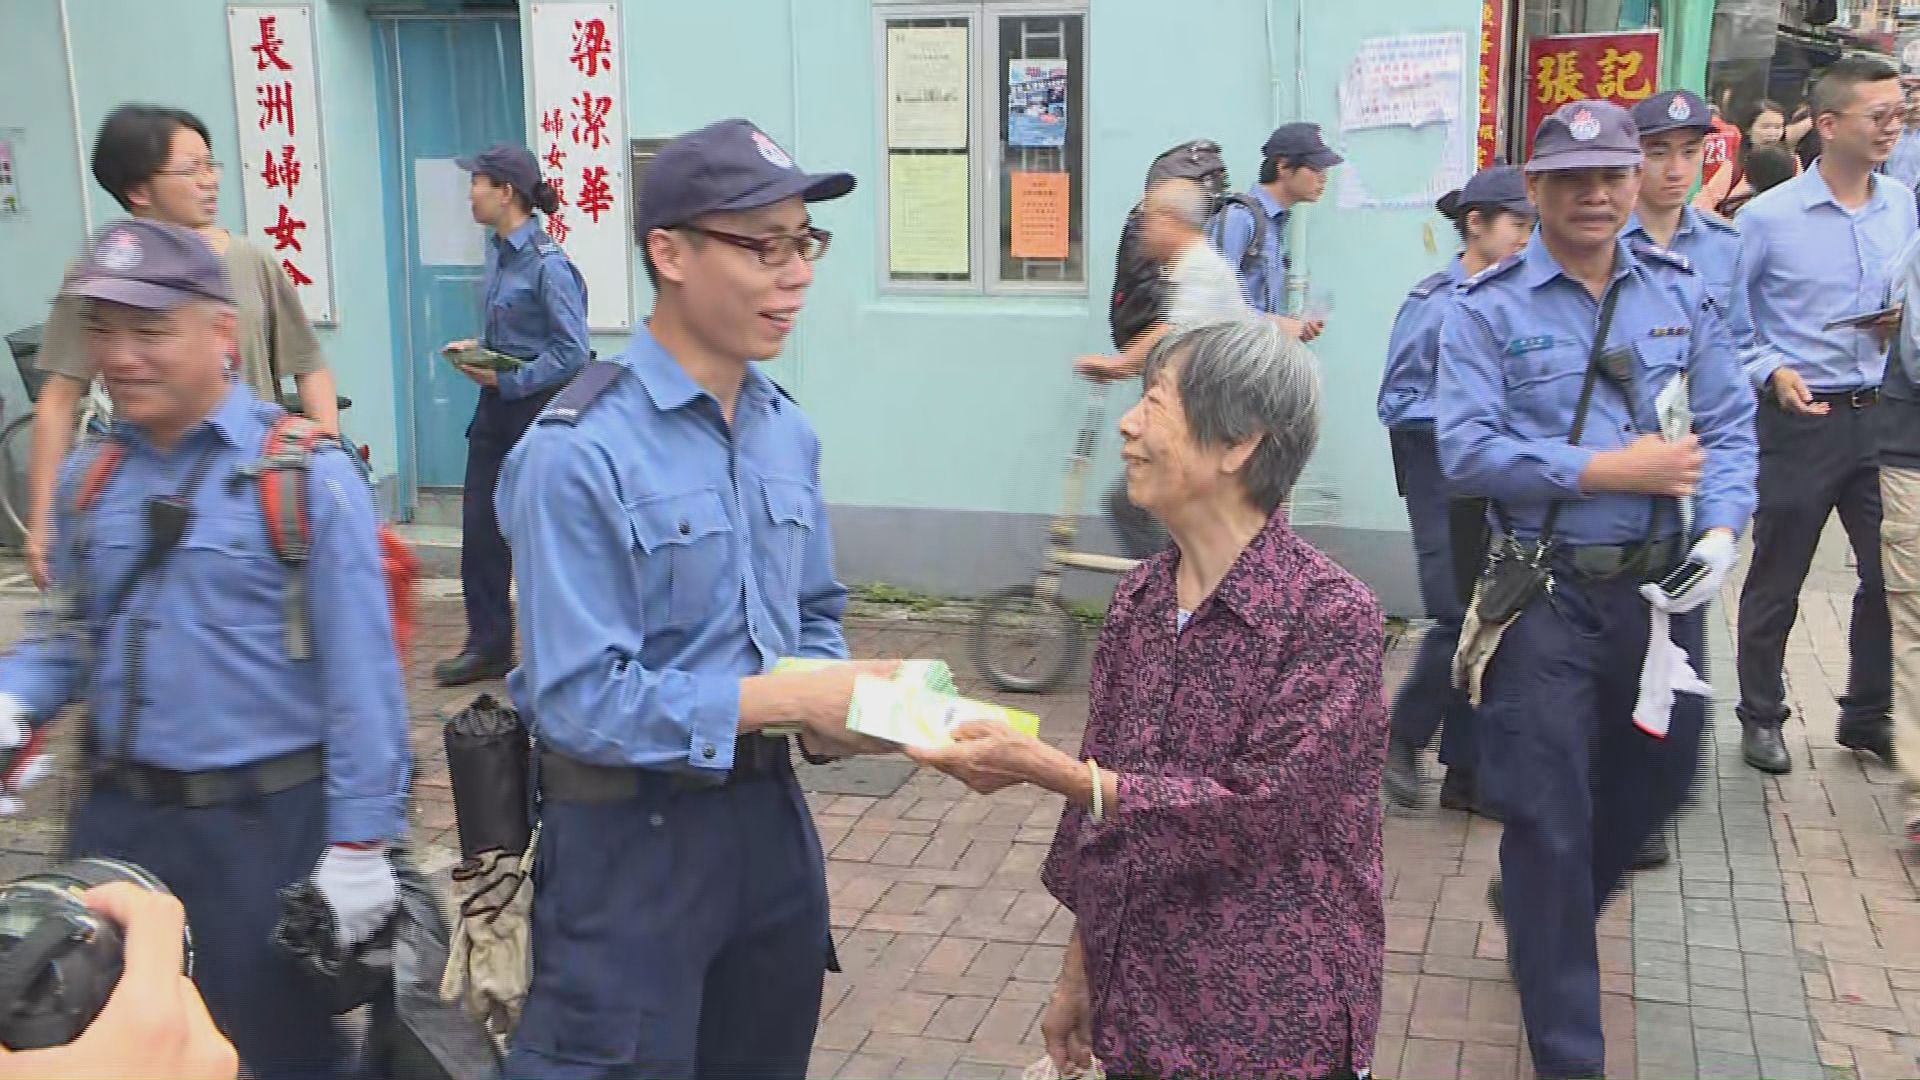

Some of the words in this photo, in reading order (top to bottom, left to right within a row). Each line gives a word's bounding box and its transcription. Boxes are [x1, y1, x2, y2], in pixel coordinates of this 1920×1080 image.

[569, 18, 614, 224] 梁潔華
[1536, 48, 1652, 103] 張記
[540, 107, 572, 260] 婦女服務
[1704, 139, 1726, 164] 23
